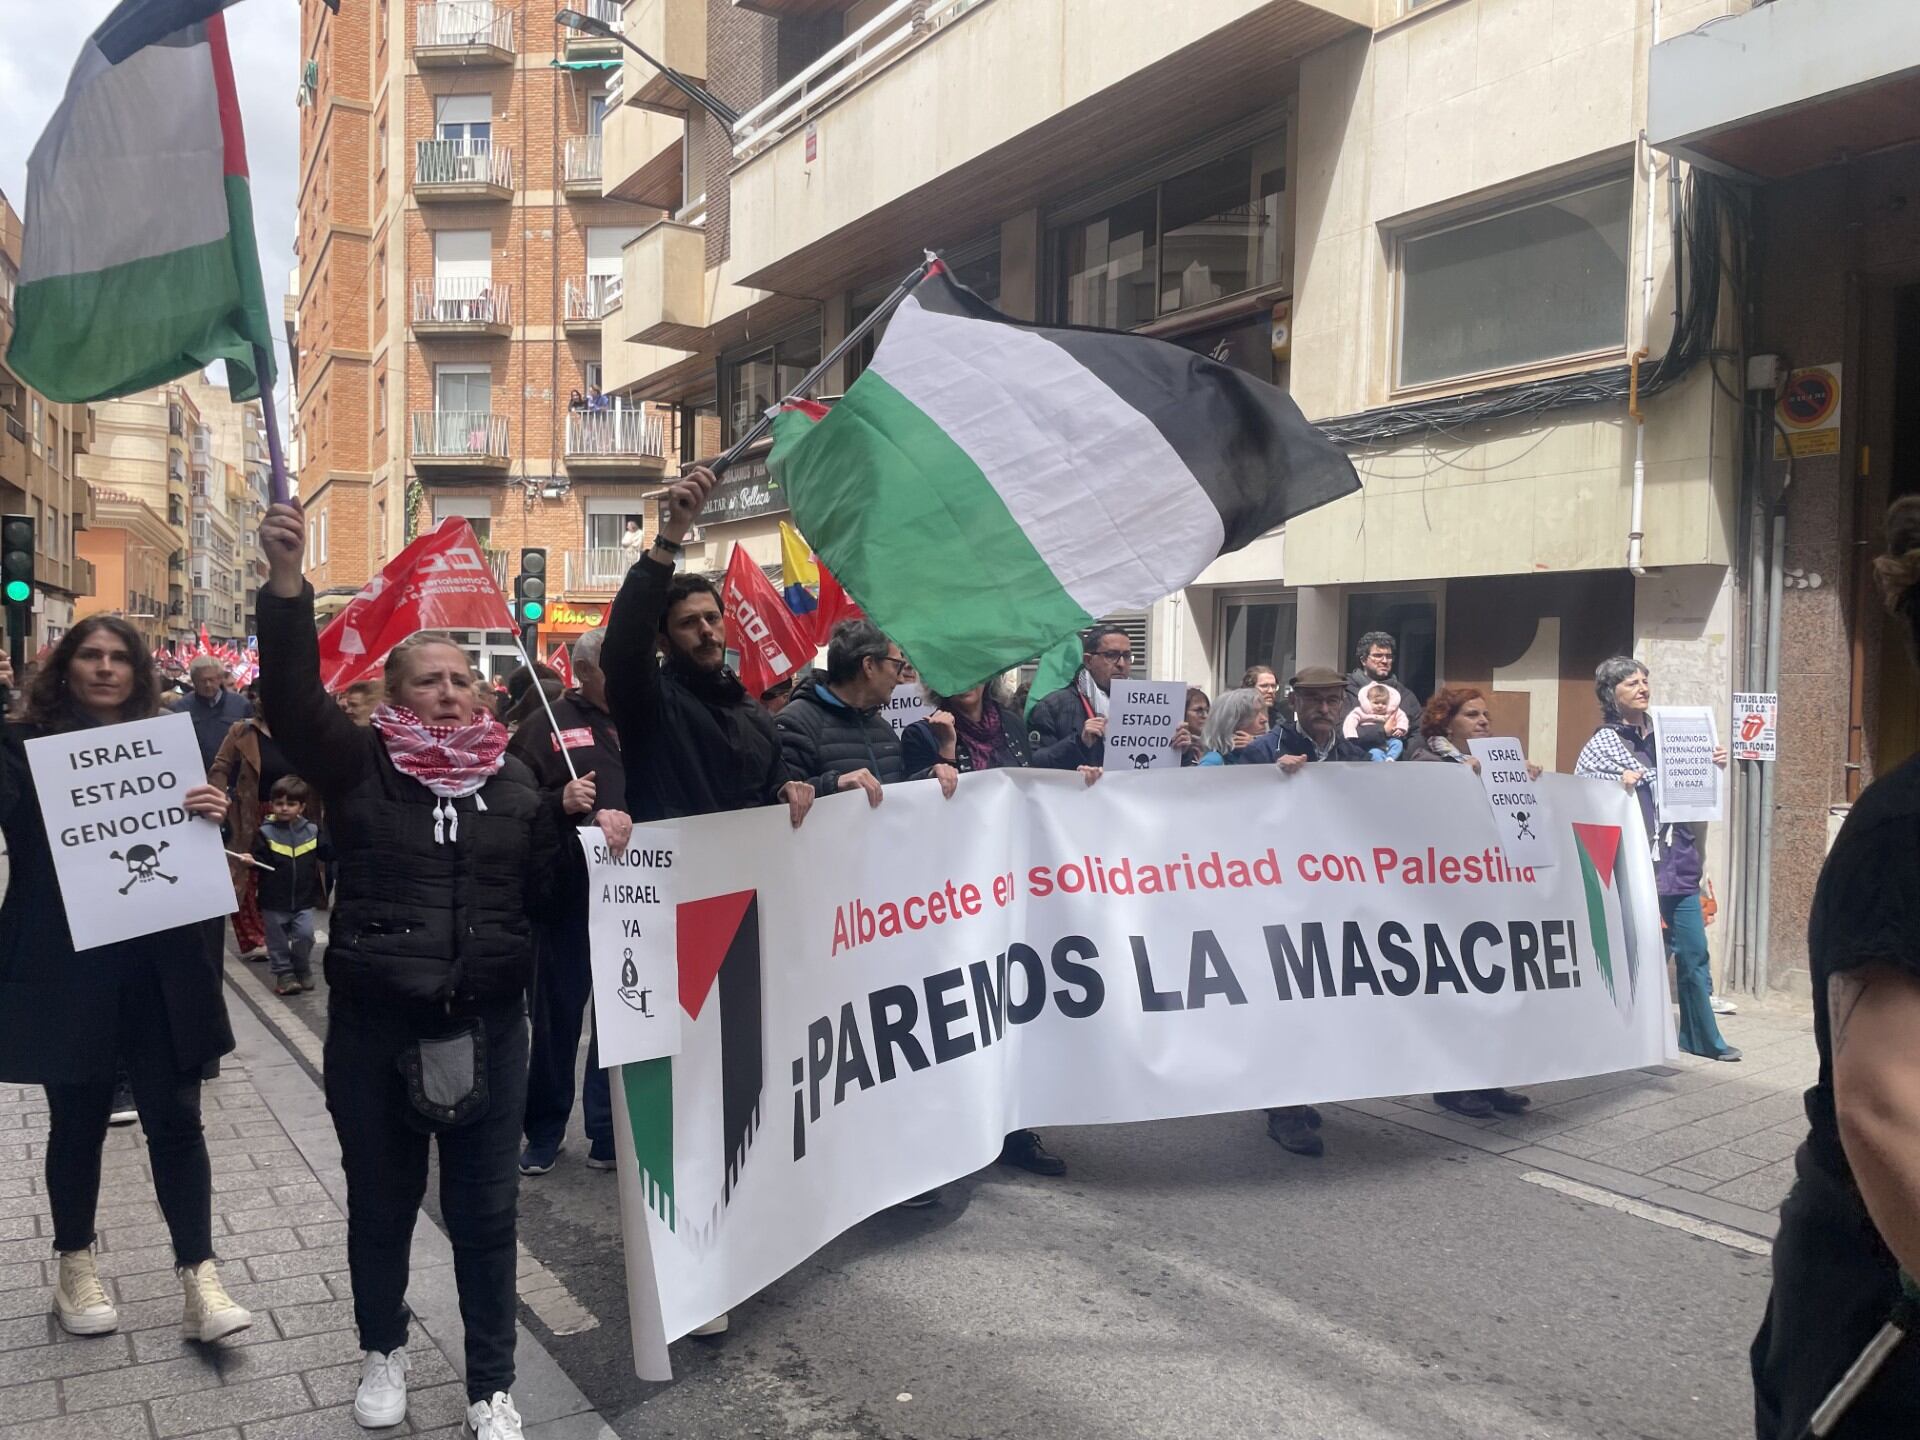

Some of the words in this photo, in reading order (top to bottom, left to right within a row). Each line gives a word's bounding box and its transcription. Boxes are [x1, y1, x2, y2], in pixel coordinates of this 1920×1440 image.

[740, 485, 771, 510] Belleza
[1127, 692, 1170, 705] ISRAEL
[1760, 696, 1777, 704] DISCO
[1121, 714, 1171, 726] ESTADO
[1666, 735, 1708, 743] COMUNIDAD
[1750, 742, 1775, 751] FLORIDA
[69, 739, 162, 770] ISRAEL
[1488, 749, 1521, 761] ISRAEL
[1492, 771, 1527, 783] ESTADO
[1669, 768, 1707, 776] GENOCIDIO
[71, 771, 176, 807] ESTADO
[1686, 780, 1703, 788] GAZA
[1492, 793, 1537, 805] GENOCIDA
[602, 884, 611, 903] A
[614, 885, 660, 904] ISRAEL
[831, 879, 982, 957] Albacete
[993, 872, 1014, 907] en
[1028, 848, 1282, 897] solidaridad
[1297, 853, 1366, 883] con
[1372, 846, 1536, 884] Palestina
[622, 919, 641, 937] YA
[792, 935, 1106, 1162] ¡PAREMOS
[1128, 929, 1249, 1012] LA
[1262, 920, 1581, 1001] MASACRE!
